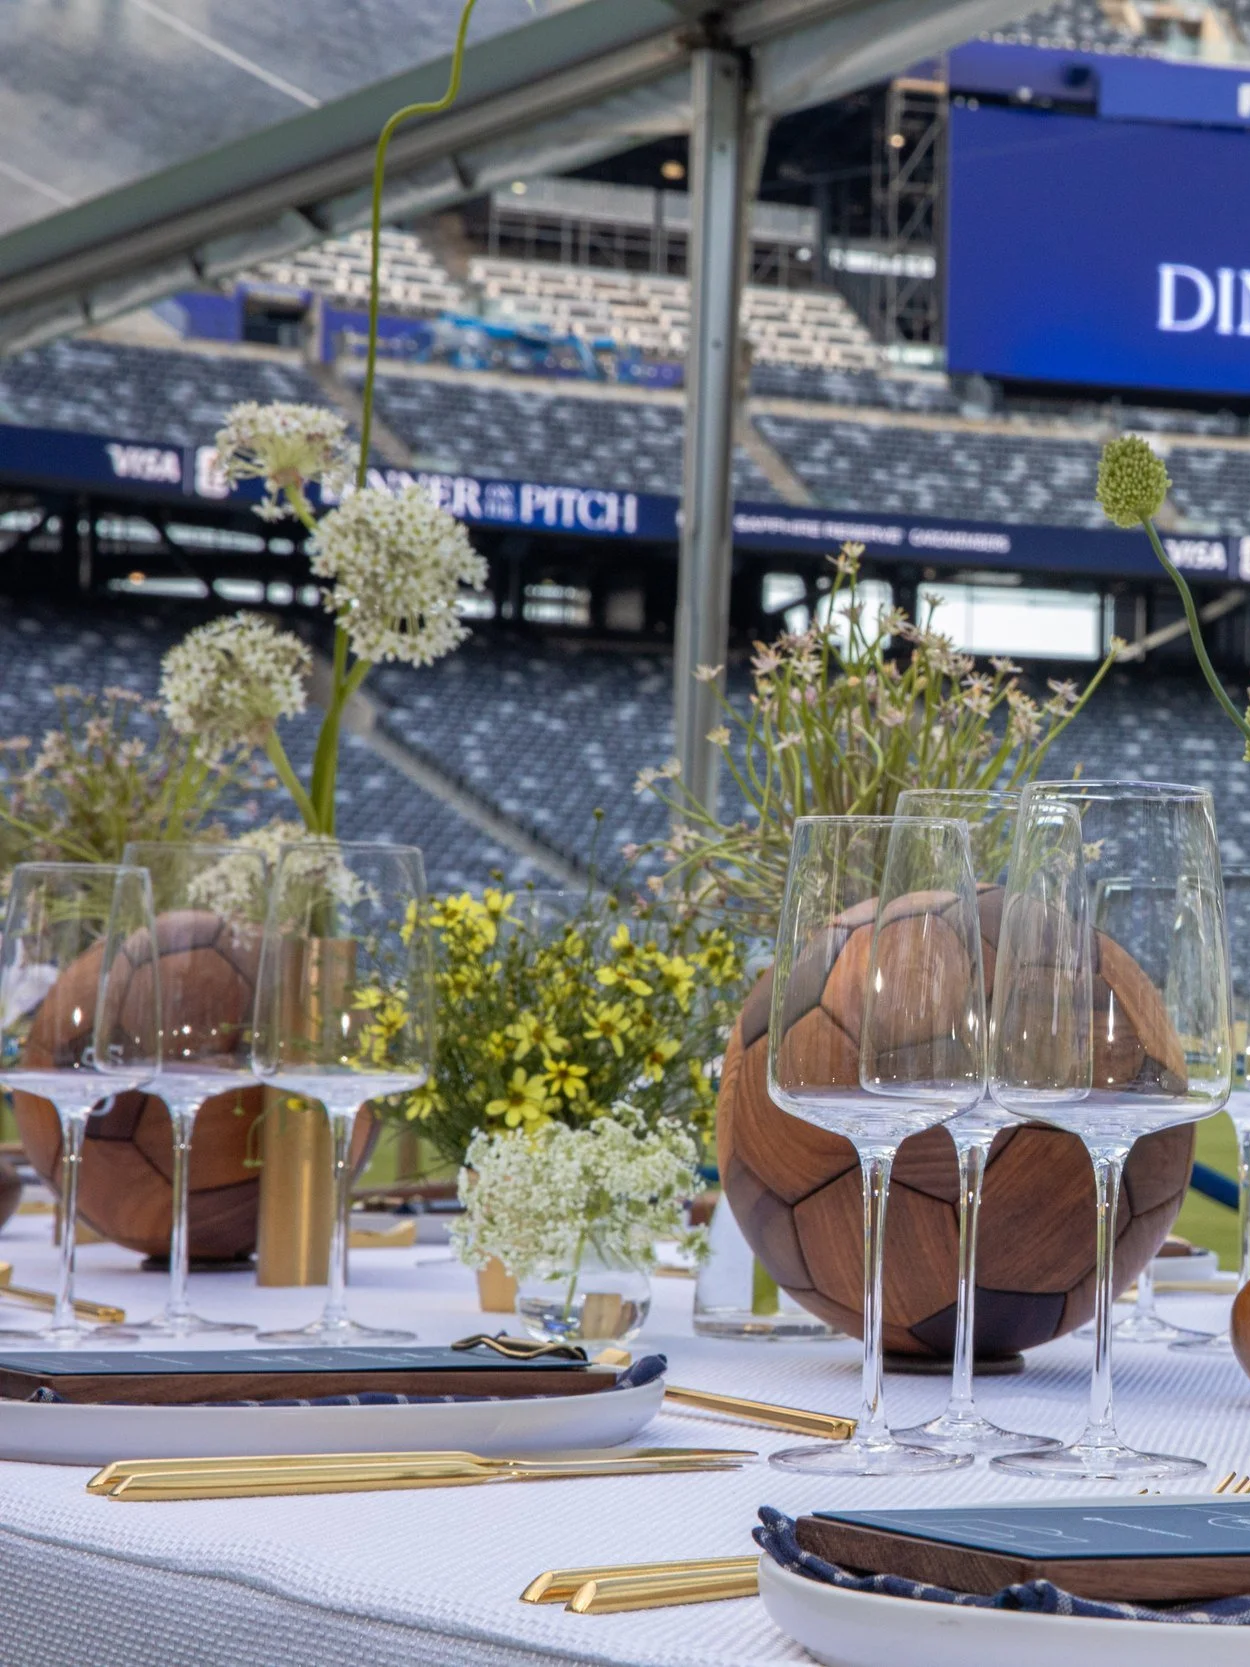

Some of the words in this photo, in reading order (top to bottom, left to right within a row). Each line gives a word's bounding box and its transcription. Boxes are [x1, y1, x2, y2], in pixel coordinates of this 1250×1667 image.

[103, 442, 180, 484] VISA
[520, 483, 638, 534] PITCH
[1164, 538, 1227, 572] VISA
